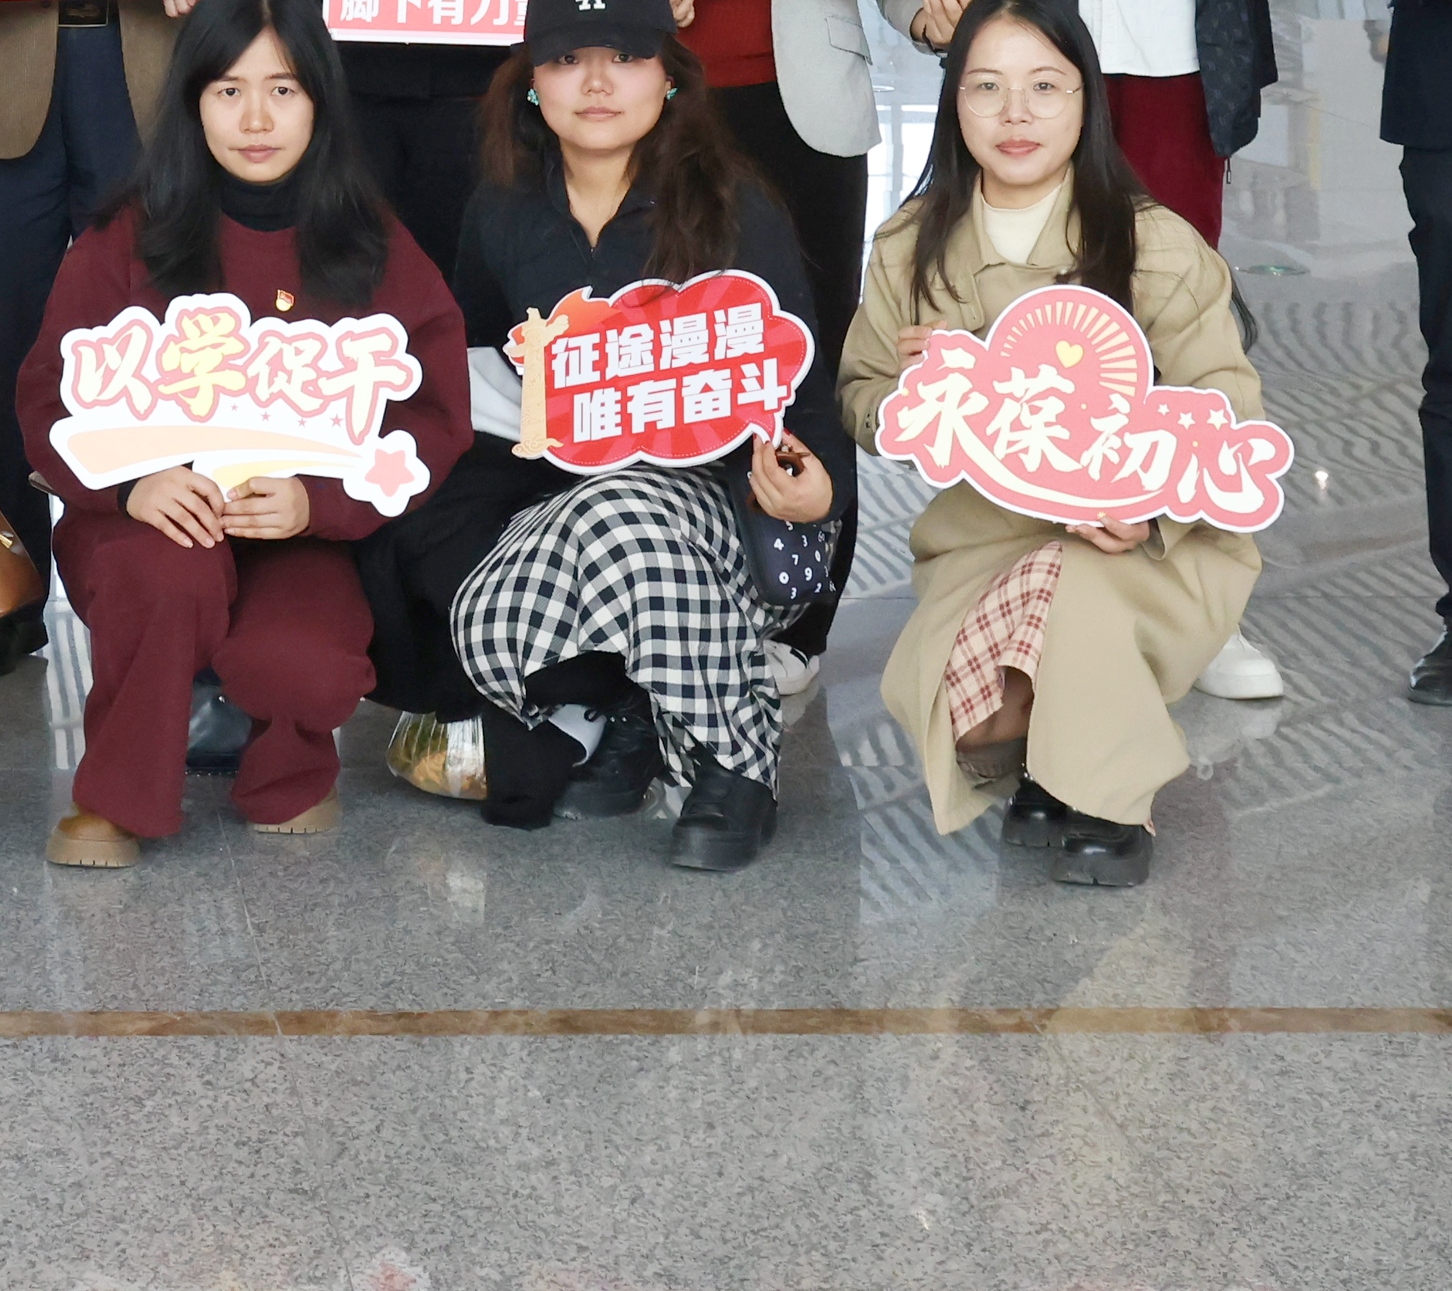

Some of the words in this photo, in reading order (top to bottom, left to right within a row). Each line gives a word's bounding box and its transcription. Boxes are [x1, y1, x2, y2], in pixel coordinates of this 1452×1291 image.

[74, 309, 411, 442] 以学促干
[550, 302, 765, 389] 征途漫漫
[573, 357, 788, 443] 唯有奋斗
[894, 346, 1276, 514] 永葆初心
